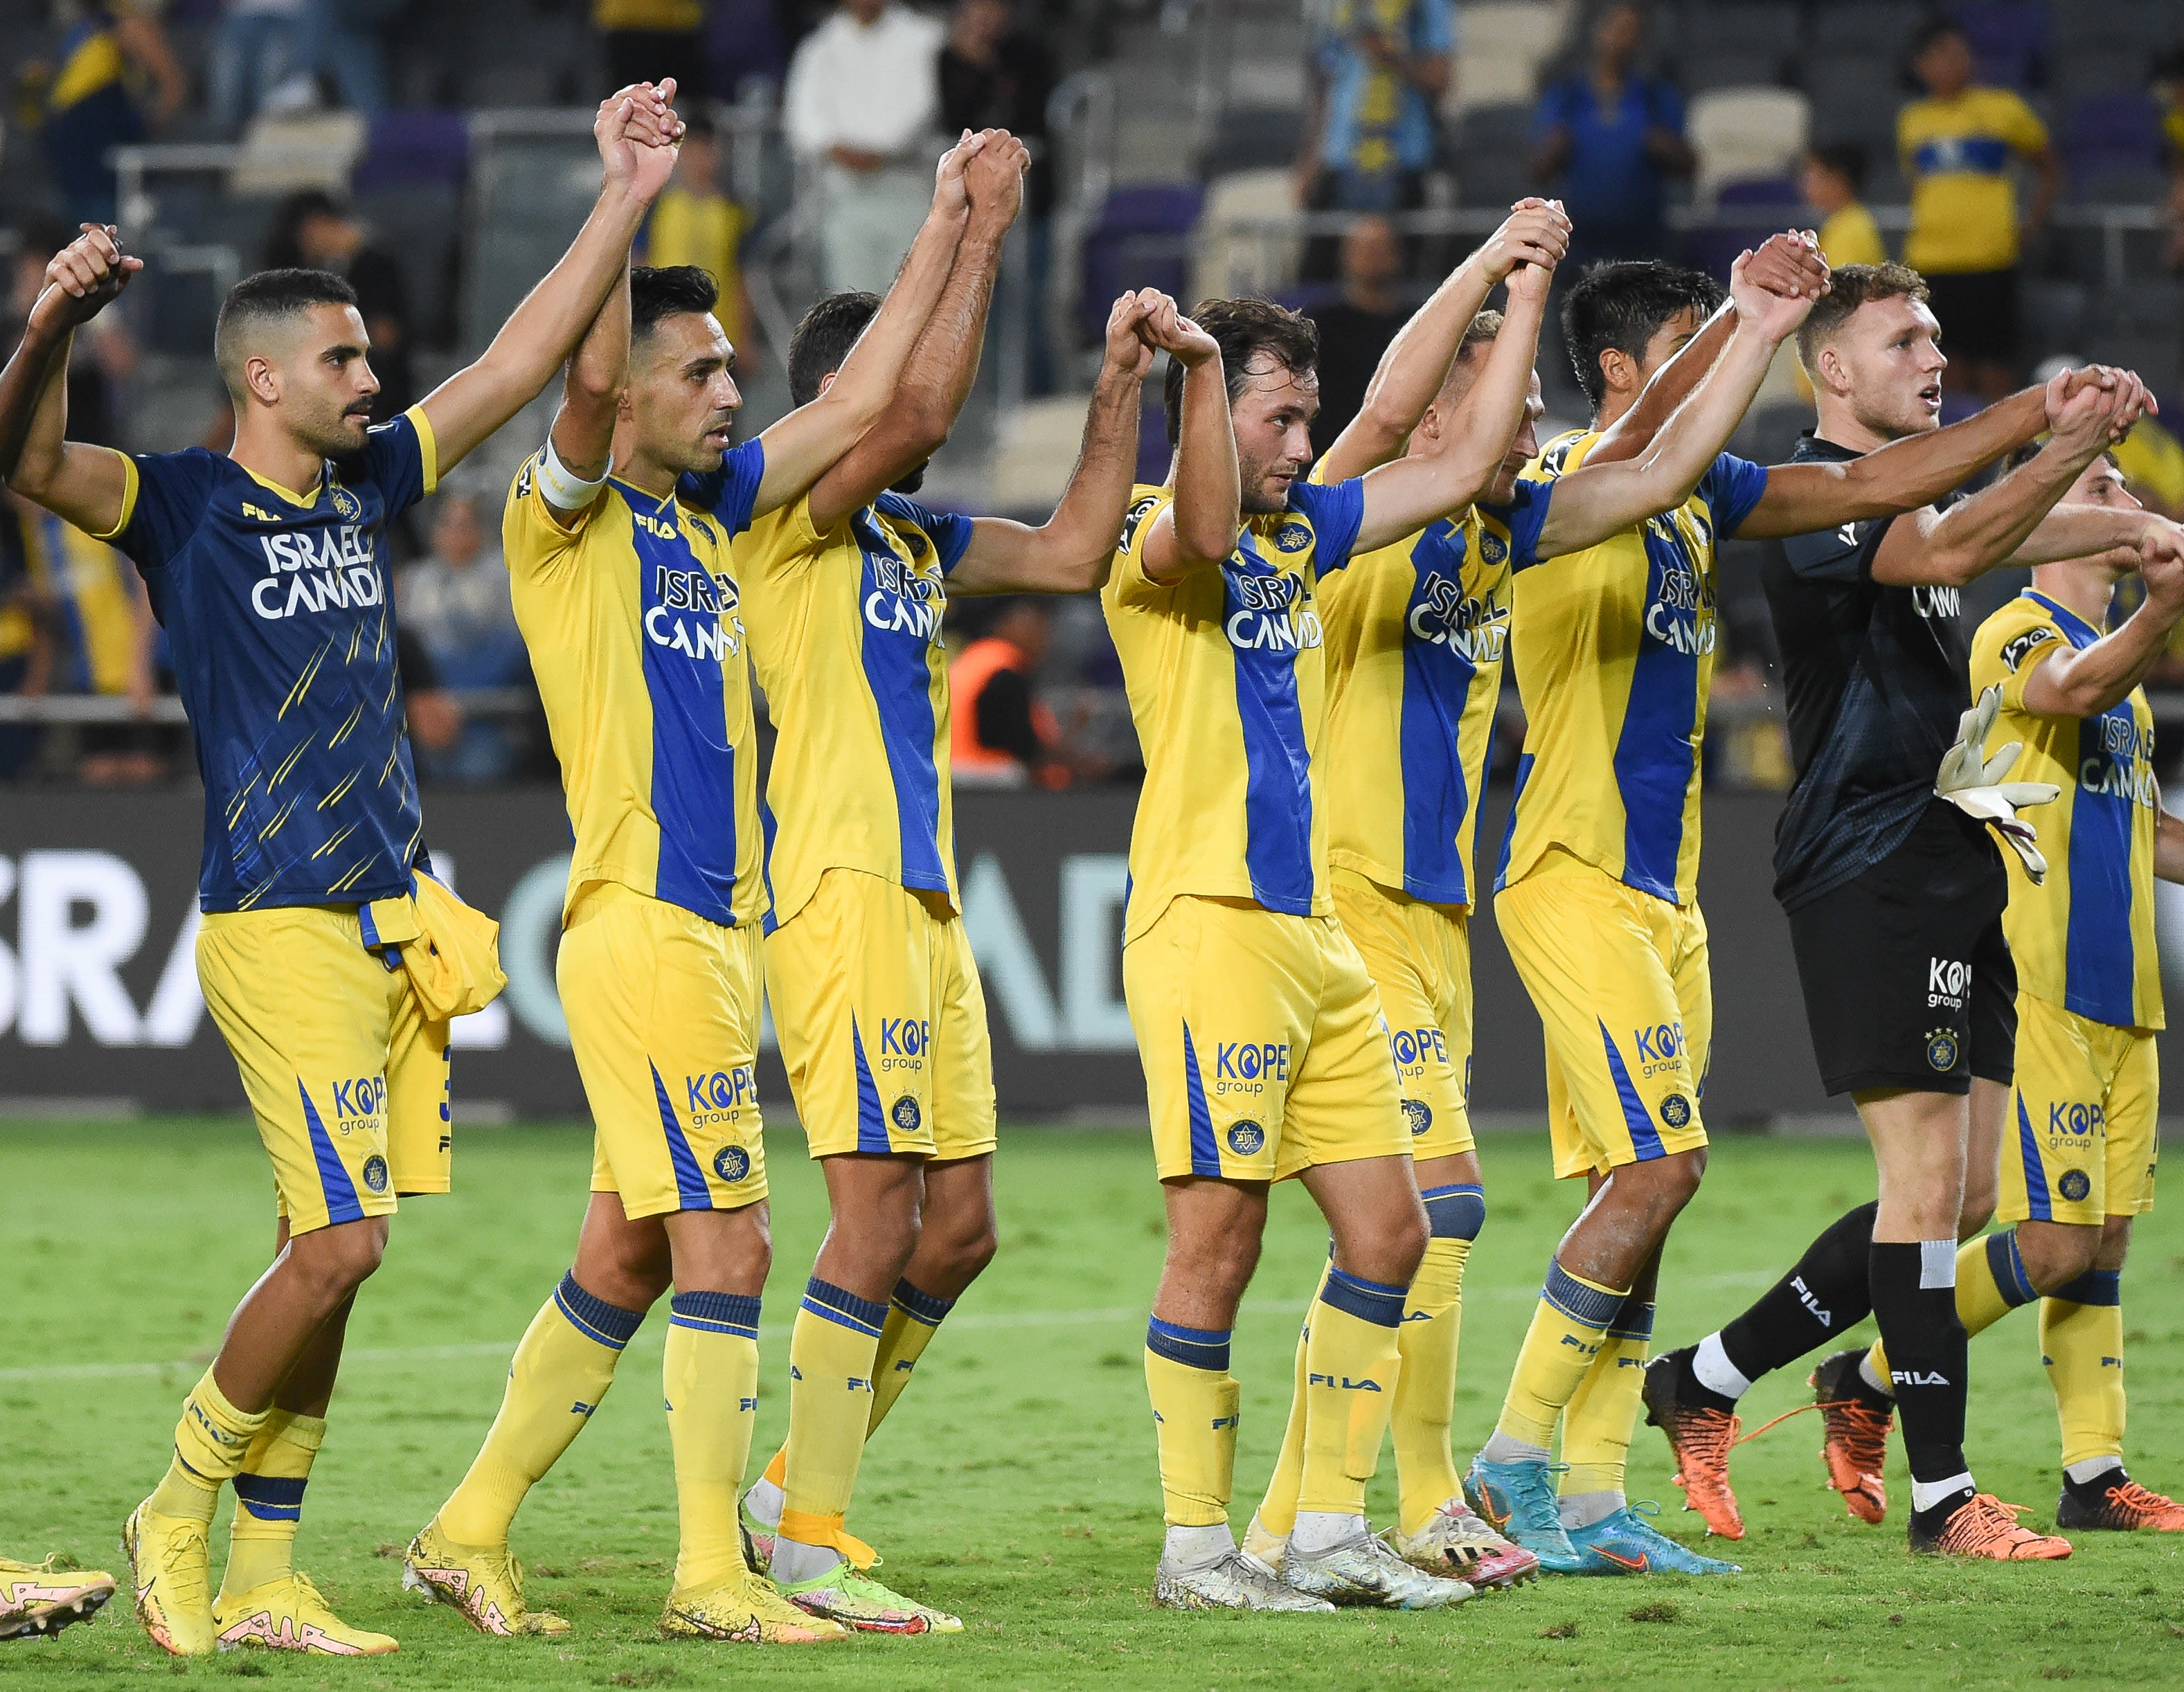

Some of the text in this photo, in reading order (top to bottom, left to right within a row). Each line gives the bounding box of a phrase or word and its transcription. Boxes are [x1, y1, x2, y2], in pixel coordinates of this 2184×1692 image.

[242, 501, 282, 521] FILA
[634, 512, 677, 540] FILA
[260, 525, 373, 574] ISRAEL
[1928, 993, 1962, 1013] group
[881, 1058, 922, 1074] group
[1217, 1042, 1289, 1081] KOPE
[1643, 1060, 1682, 1079] group
[332, 1076, 388, 1119] KOP
[1217, 1081, 1264, 1098] group
[339, 1116, 380, 1135] group
[692, 1110, 739, 1129] group
[2050, 1137, 2091, 1152] group
[1789, 1275, 1832, 1327] FILA
[1310, 1373, 1382, 1392] FILA
[1891, 1371, 1951, 1385] FILA
